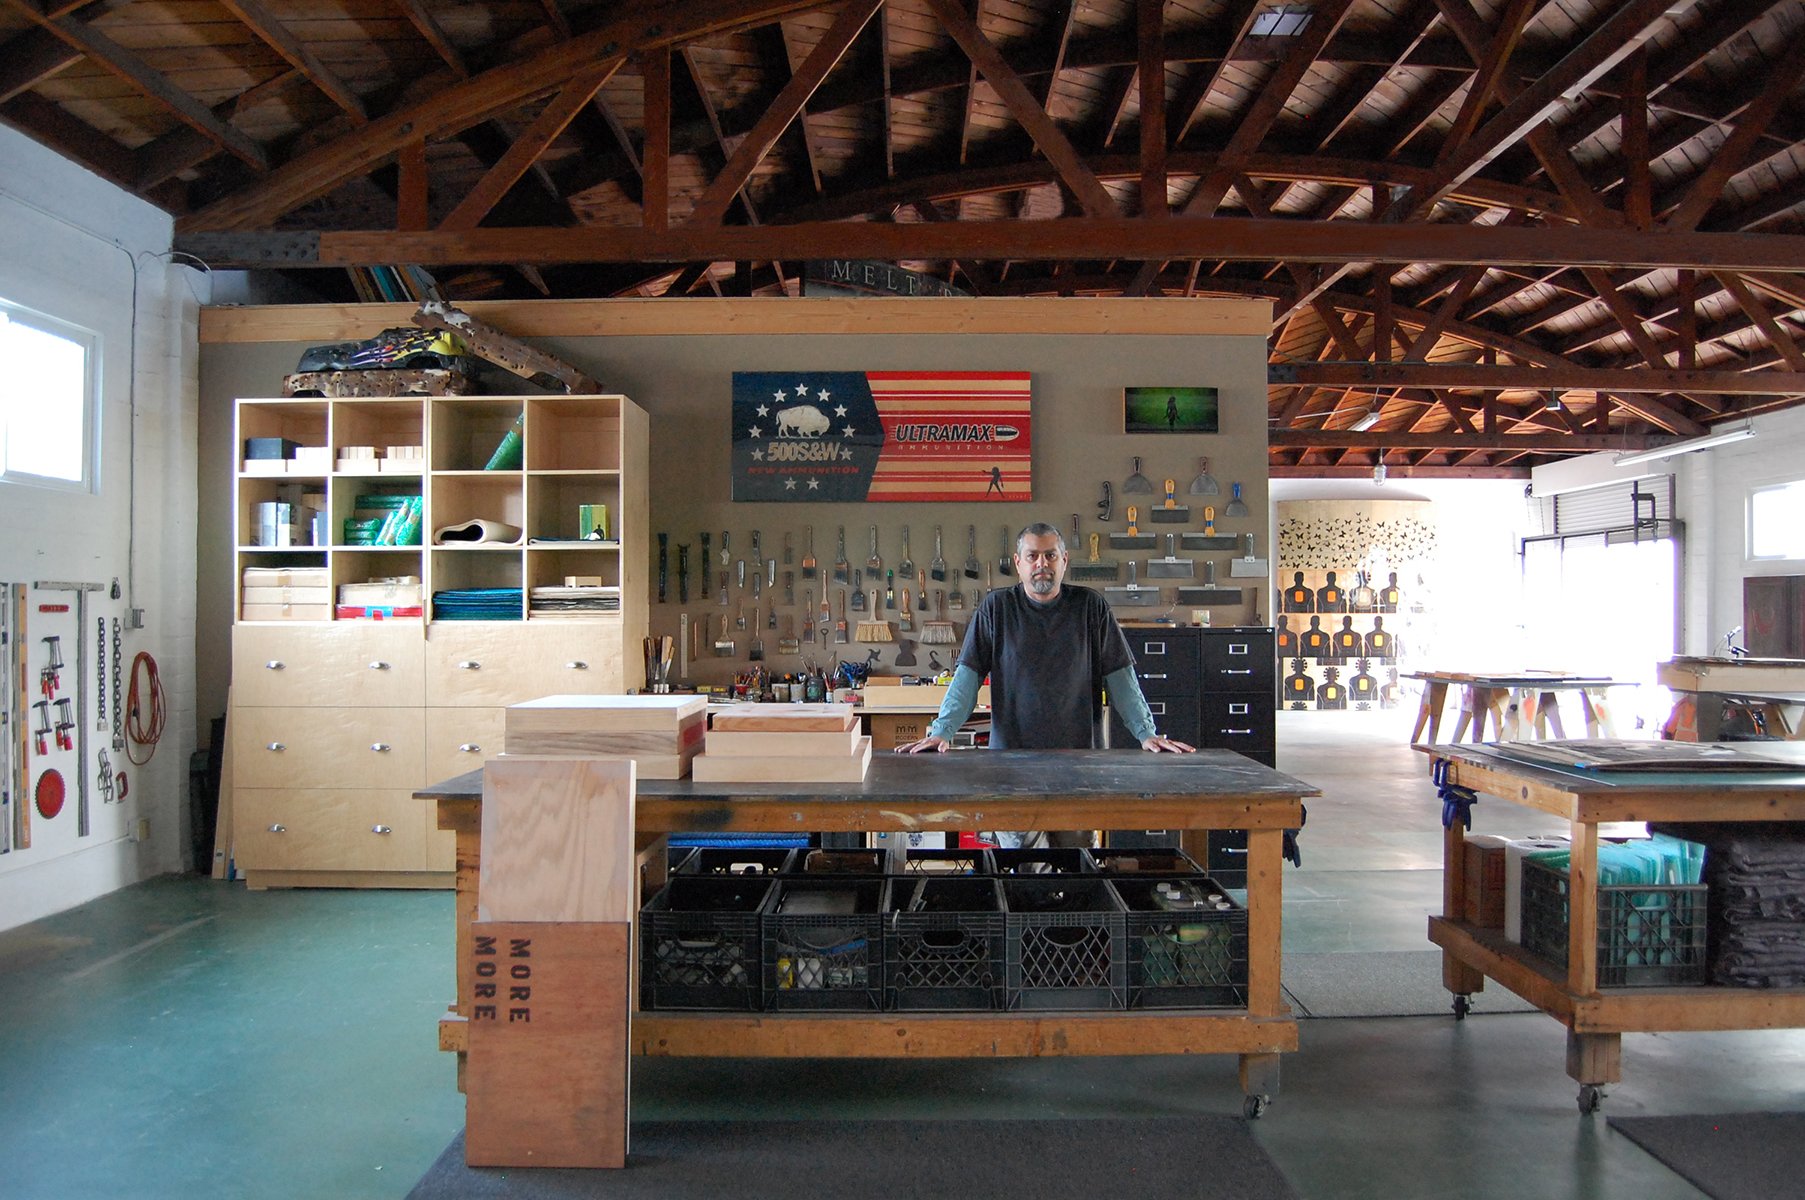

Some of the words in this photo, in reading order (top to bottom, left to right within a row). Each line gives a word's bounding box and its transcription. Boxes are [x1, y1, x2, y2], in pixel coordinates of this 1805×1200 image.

[896, 423, 992, 442] ULTRAMAX
[767, 441, 840, 462] 500S&W
[778, 465, 860, 475] AMMUNITION
[475, 936, 497, 1020] MORE
[509, 938, 531, 1023] MORE
